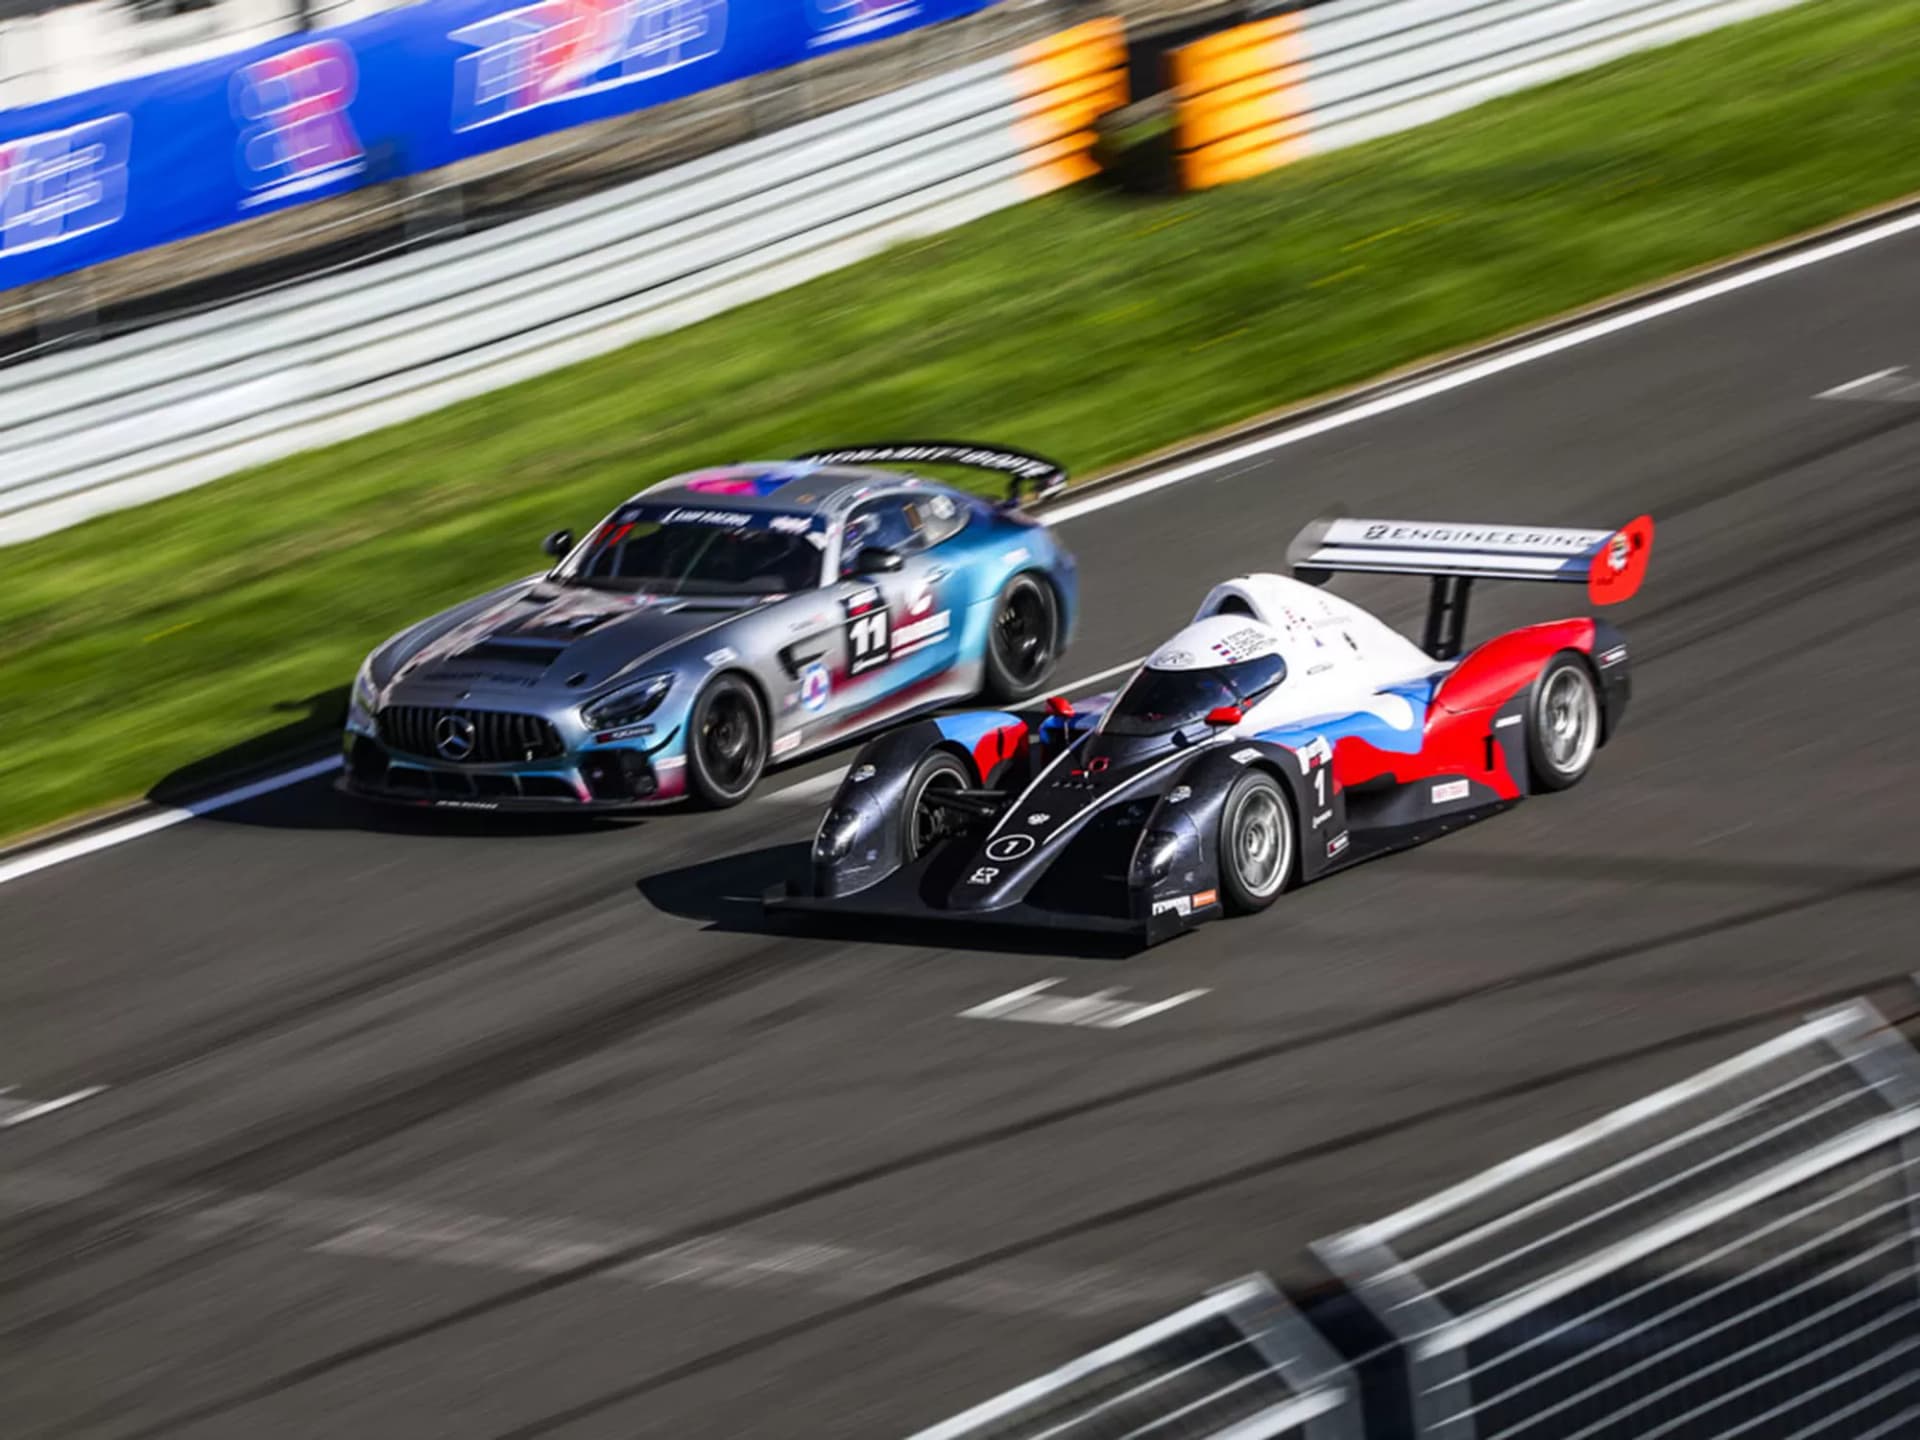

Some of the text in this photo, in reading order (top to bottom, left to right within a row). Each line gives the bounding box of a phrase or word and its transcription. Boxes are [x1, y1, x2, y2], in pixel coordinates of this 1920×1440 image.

[1389, 527, 1595, 547] ENGINEERING
[850, 611, 887, 656] 11
[1314, 768, 1325, 806] 1
[1003, 840, 1019, 854] 1
